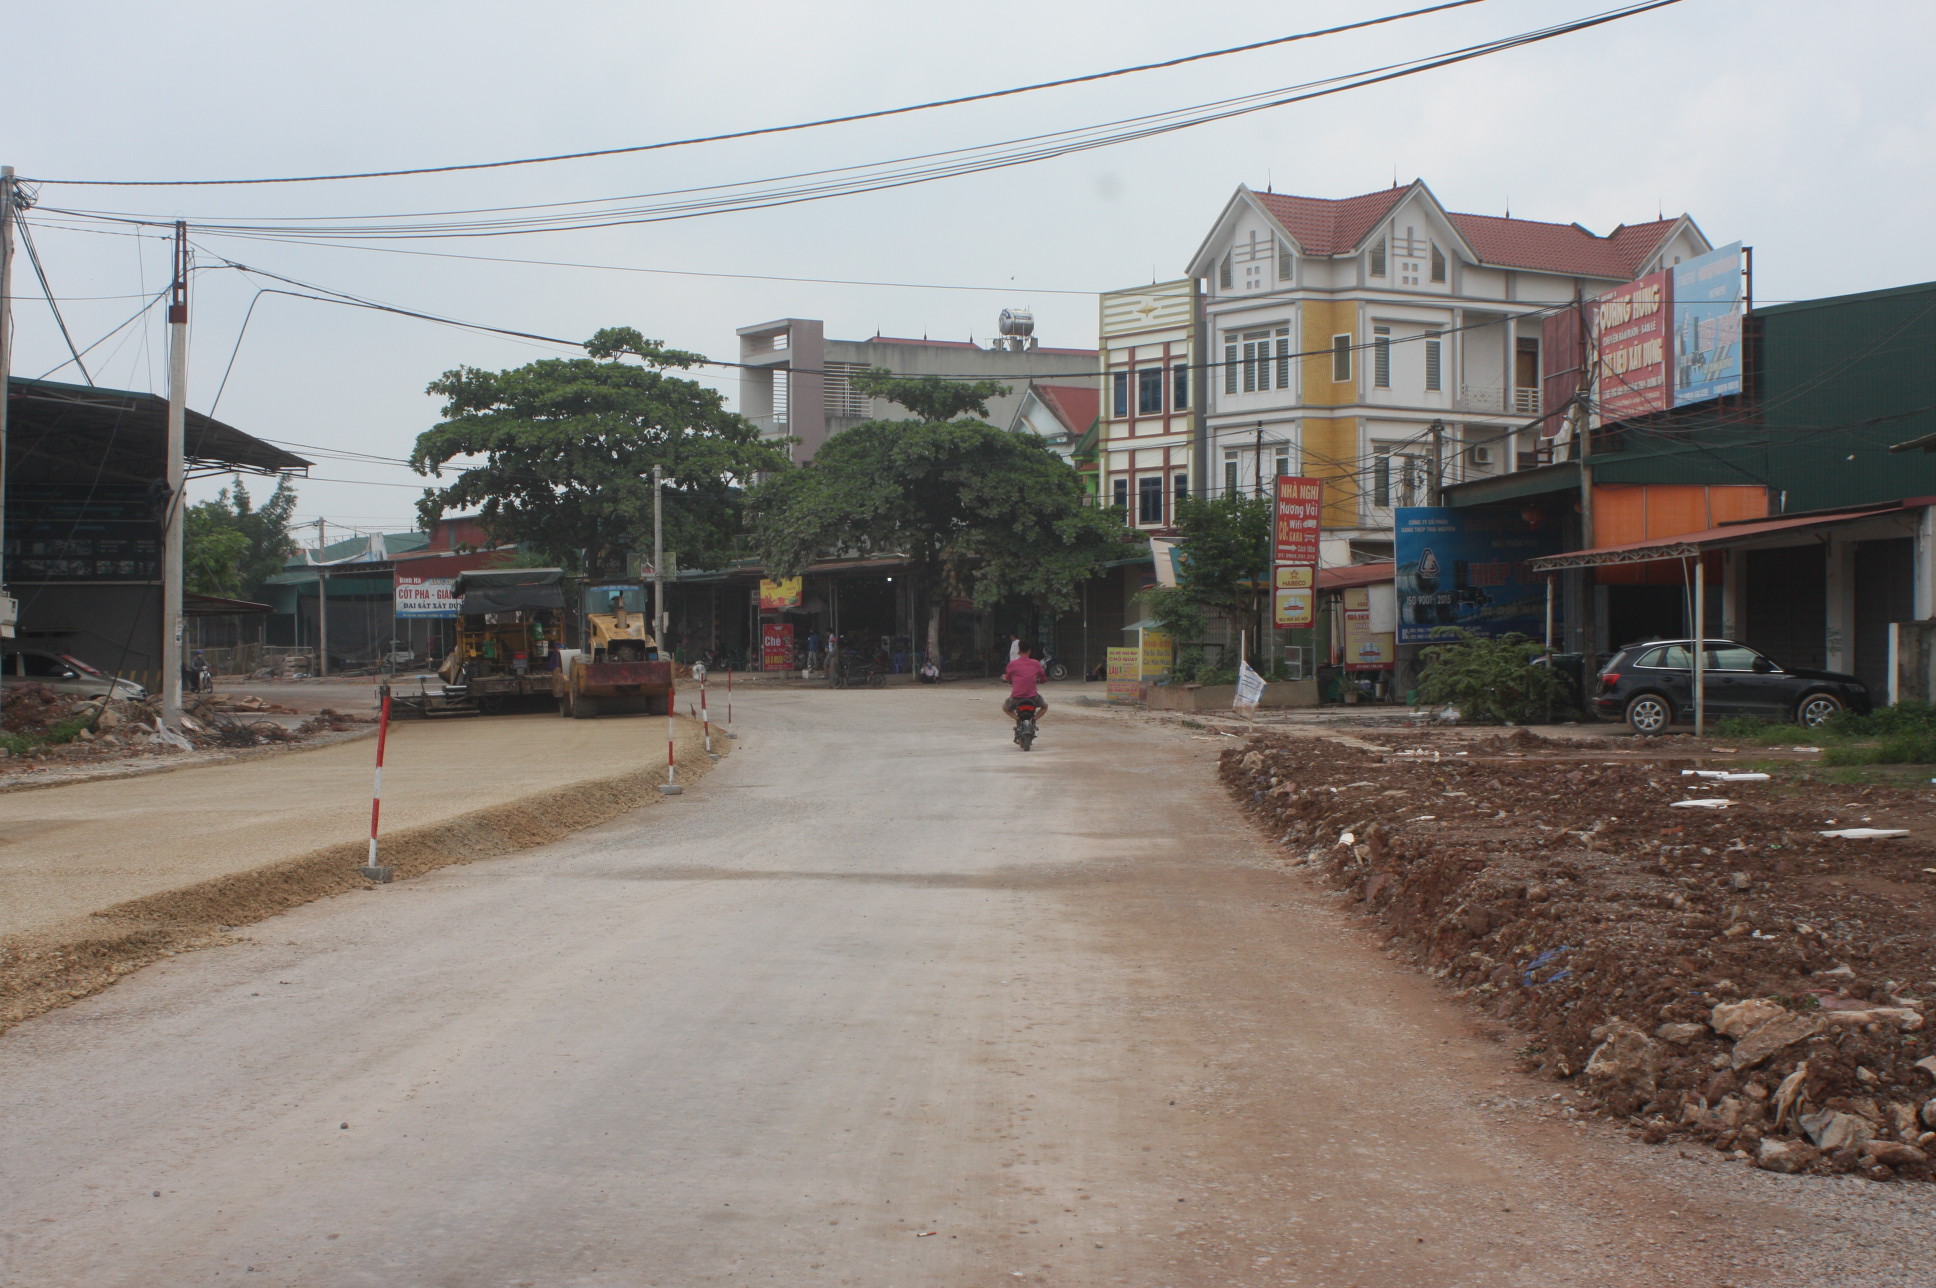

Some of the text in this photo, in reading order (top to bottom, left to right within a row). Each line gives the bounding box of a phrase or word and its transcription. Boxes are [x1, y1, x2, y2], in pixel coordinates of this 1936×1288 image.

[1281, 481, 1319, 500] NHÀ NGHỈ
[1280, 501, 1318, 518] Hương Vải
[1289, 519, 1302, 529] Wifi
[399, 585, 413, 599] CỐT
[432, 601, 447, 609] XÂY
[1406, 595, 1417, 605] ISO
[1418, 595, 1432, 605] 9001
[765, 634, 781, 646] Chè
